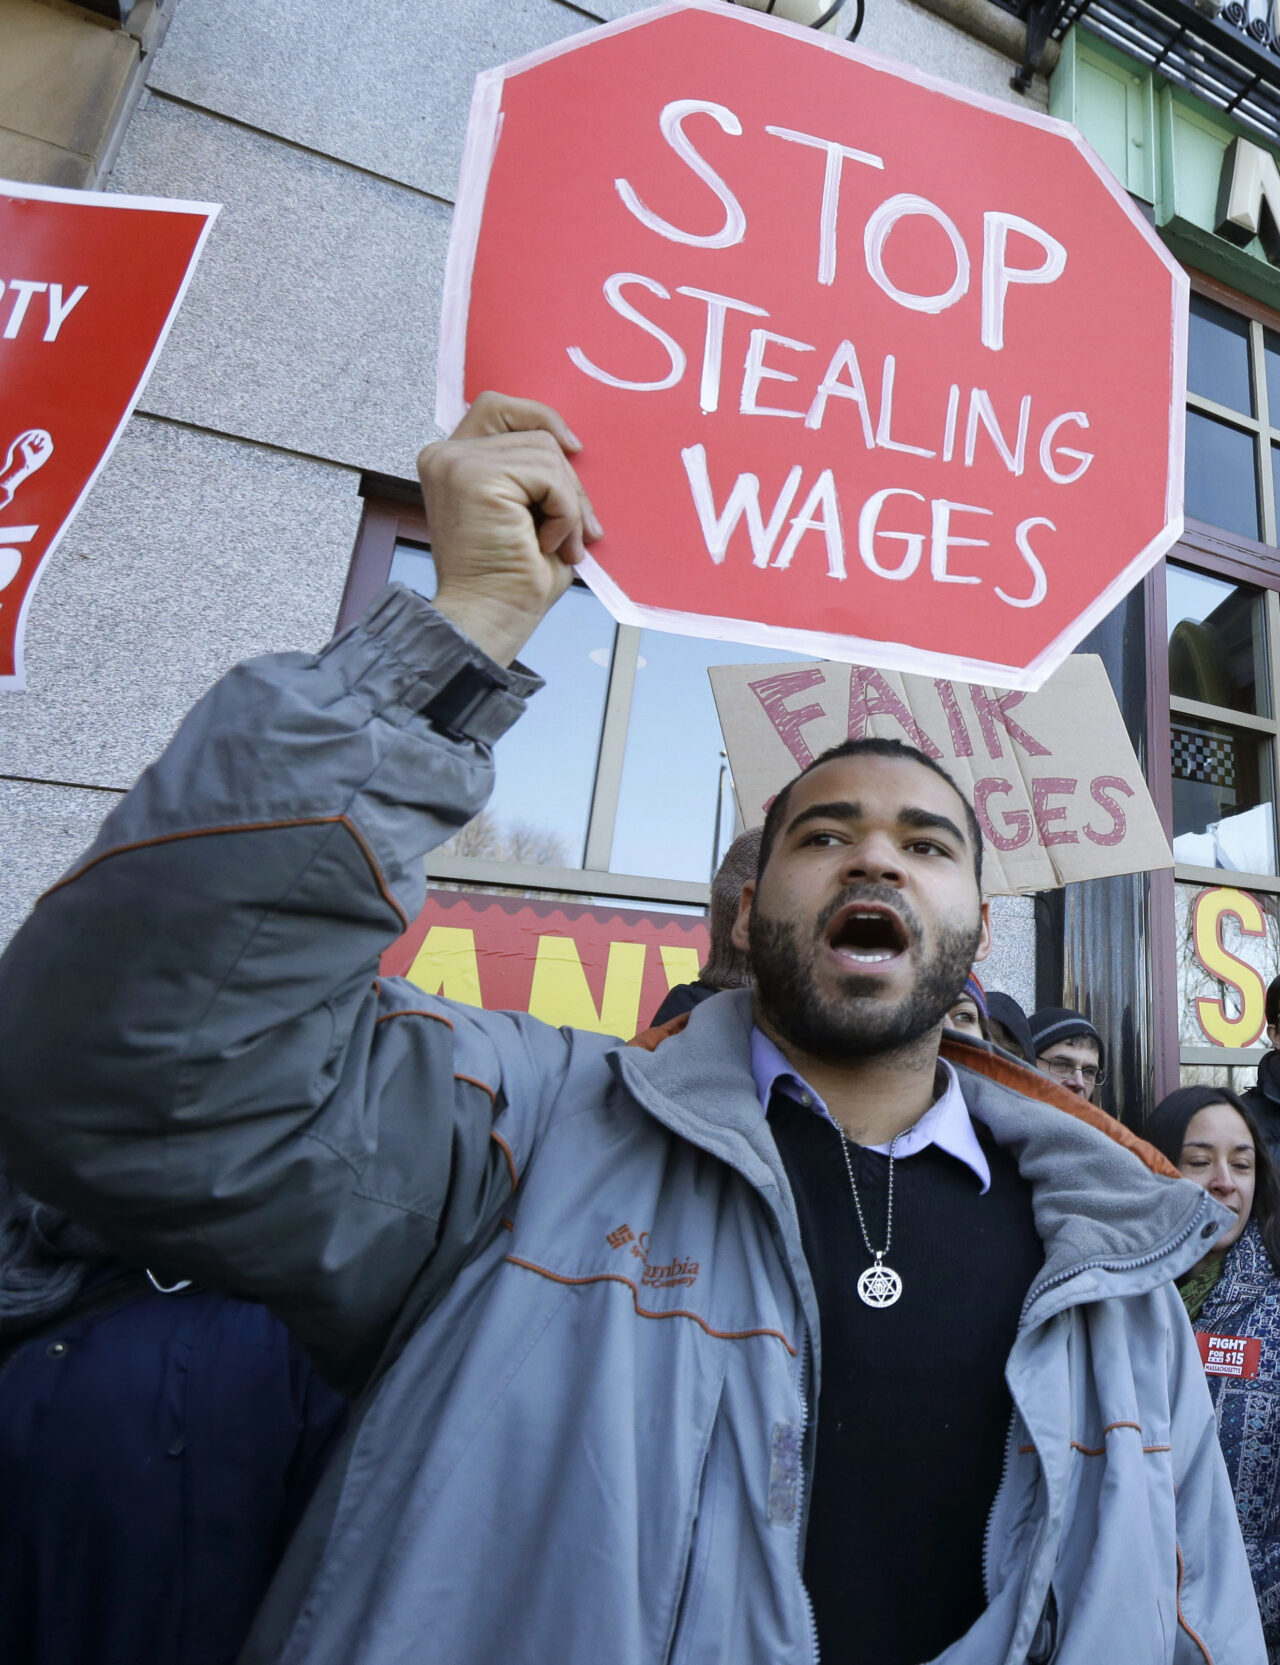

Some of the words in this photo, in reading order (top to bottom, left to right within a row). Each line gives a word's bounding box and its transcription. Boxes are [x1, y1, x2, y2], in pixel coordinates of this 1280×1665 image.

[615, 98, 1068, 352] STOP
[0, 278, 89, 342] TY
[566, 271, 1095, 484] STEALING
[681, 443, 1057, 609] WAGES
[747, 664, 1053, 771] FAIR
[1208, 1337, 1247, 1351] FIGHT
[1208, 1350, 1225, 1358] FOR
[1225, 1351, 1245, 1365] $15
